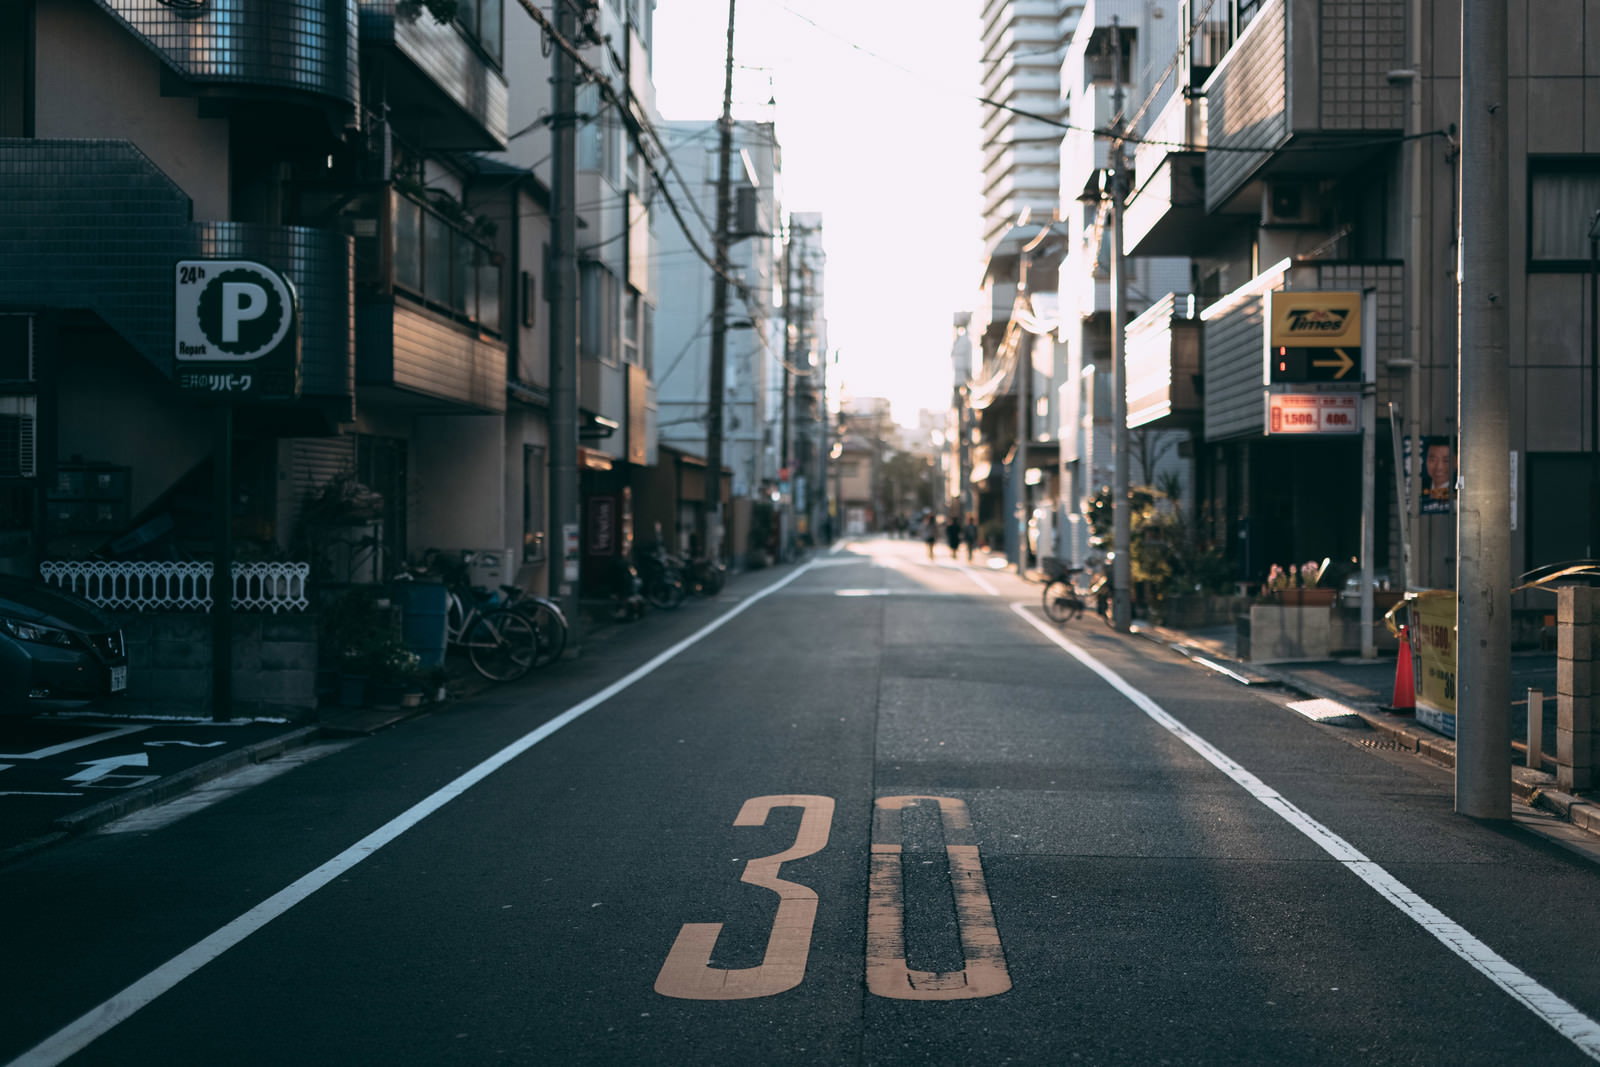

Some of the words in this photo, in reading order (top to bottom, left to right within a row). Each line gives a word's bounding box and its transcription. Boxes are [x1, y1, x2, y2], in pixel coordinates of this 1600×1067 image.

[180, 267, 205, 284] 24h
[222, 282, 268, 342] P
[1286, 309, 1350, 331] Times
[180, 341, 207, 356] Repark
[653, 795, 1012, 1000] 30
